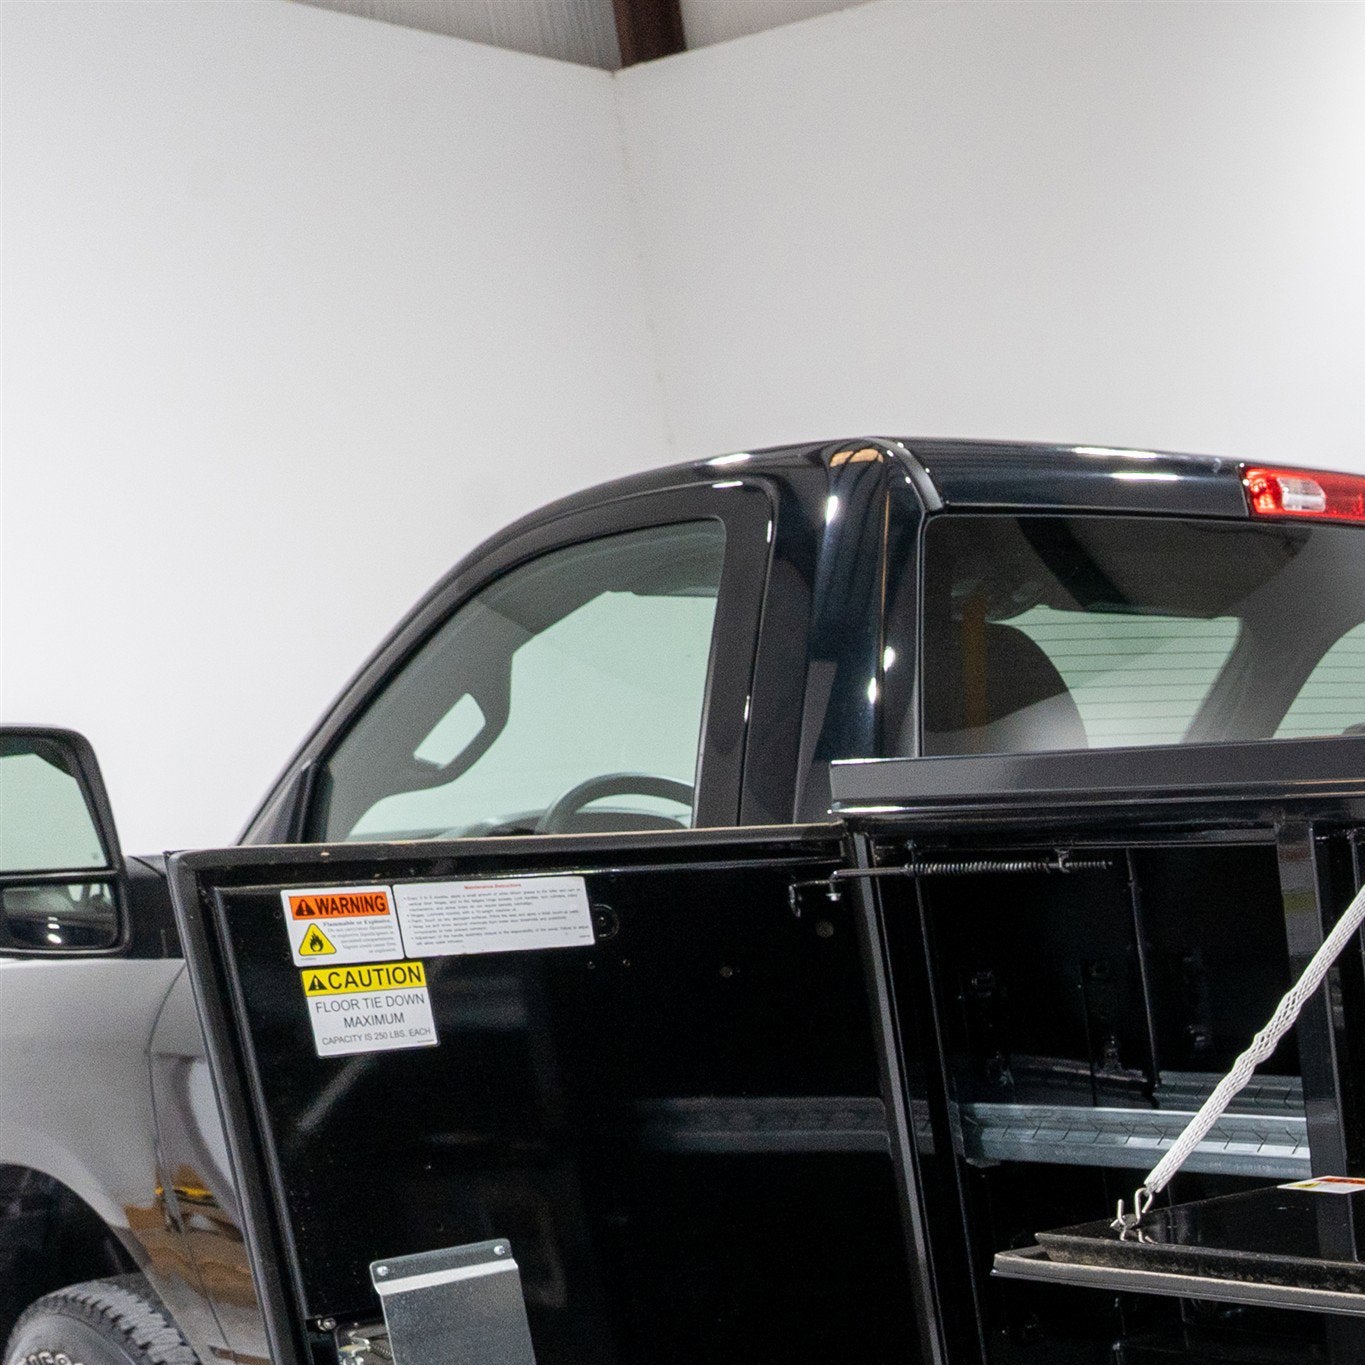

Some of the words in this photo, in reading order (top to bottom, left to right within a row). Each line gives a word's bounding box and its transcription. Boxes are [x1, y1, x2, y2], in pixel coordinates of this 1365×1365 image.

[315, 895, 386, 915] WARNING
[327, 965, 422, 990] CAUTION
[315, 998, 360, 1013] FLOOR
[362, 996, 383, 1009] TIE
[385, 993, 426, 1007] DOWN
[343, 1012, 406, 1028] MAXIMUM
[321, 1034, 363, 1046] CAPACITY
[364, 1033, 373, 1041] IS
[374, 1032, 388, 1040] 250
[389, 1030, 406, 1039] LBS.
[408, 1027, 431, 1037] EACH
